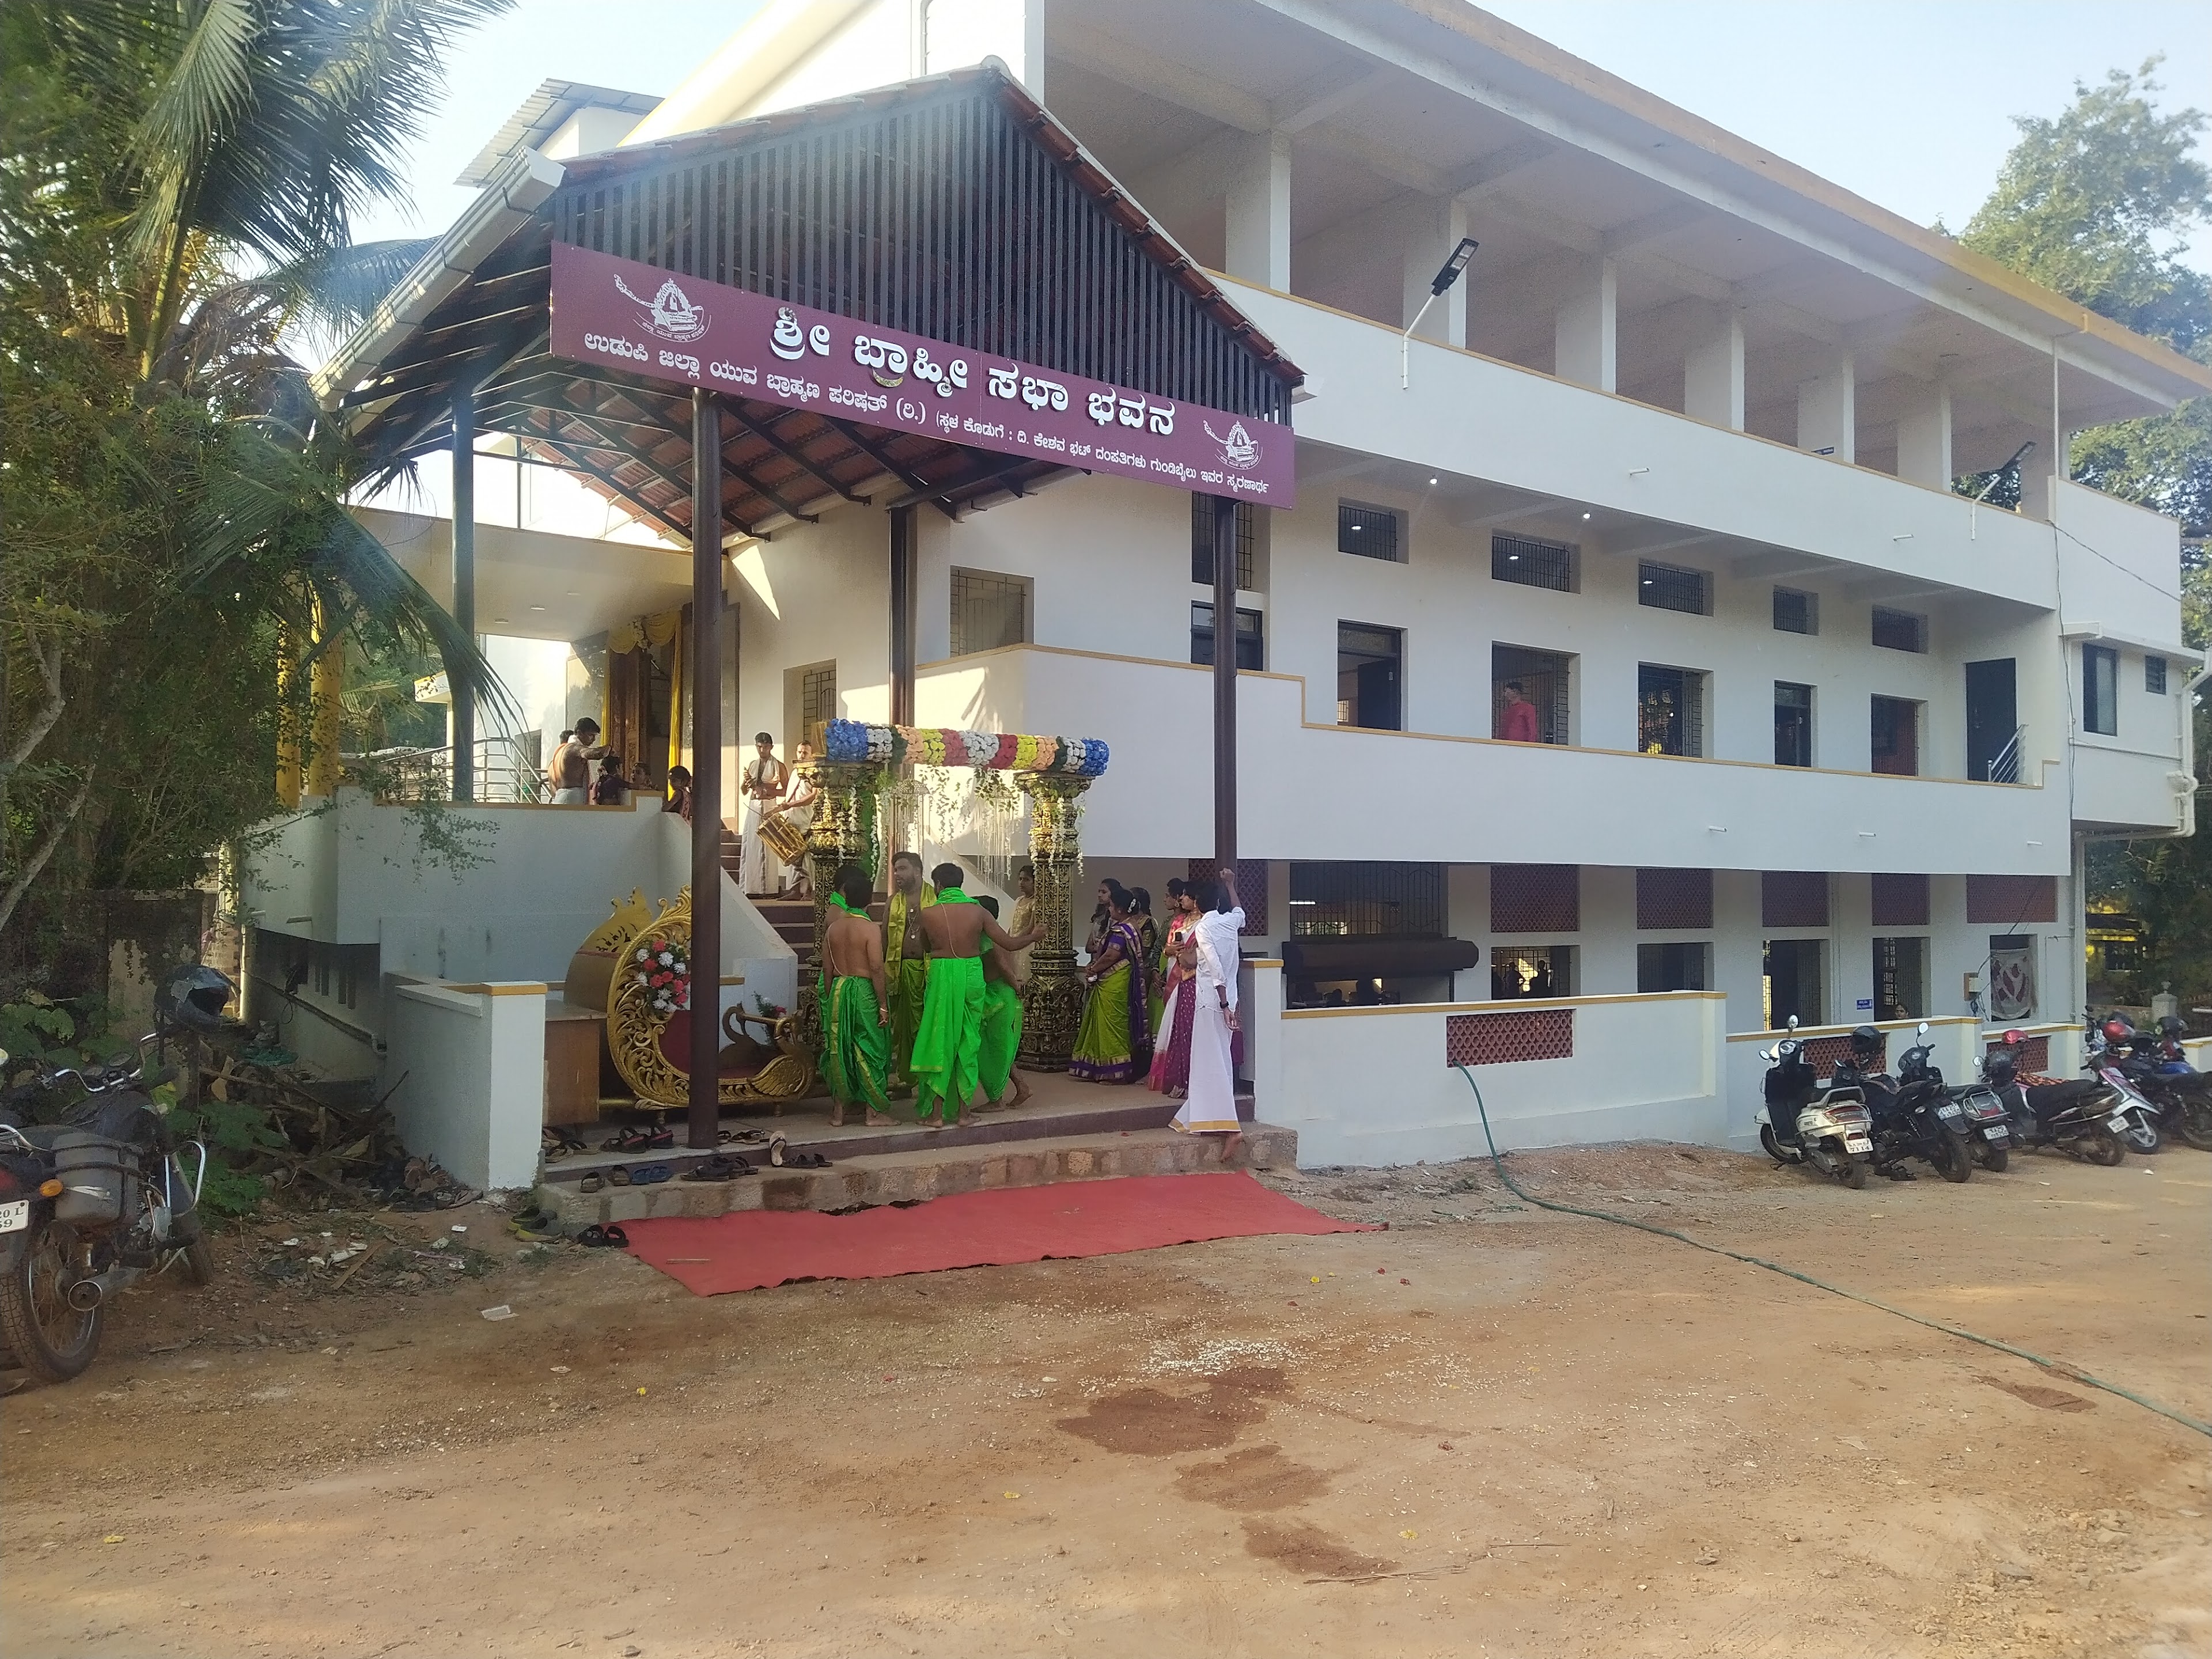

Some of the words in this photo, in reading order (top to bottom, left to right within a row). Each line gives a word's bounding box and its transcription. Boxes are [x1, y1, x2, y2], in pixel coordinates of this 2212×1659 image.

[585, 334, 648, 361] ಉಡುಪಿ
[660, 350, 699, 379] ಜಿಲ್ಲಾ
[710, 359, 757, 384] ಯುವ
[767, 374, 820, 402] ಬ್ರಾಹ್ಮಣ
[829, 384, 887, 411] ಪರಿಷತ್
[897, 398, 925, 424] (ರಿ.)
[770, 308, 830, 359] ಶ್ರೀ
[854, 335, 968, 397] ಬ್ರಾಹ್ಮೀ
[989, 363, 1068, 410] ಸಭಾ
[1089, 387, 1175, 434] ಭವನ
[964, 418, 1003, 438] ಕೊಡುಗೆ
[1034, 433, 1065, 451] ಕೇಶವ
[1070, 441, 1090, 456] ಭಟ್
[1096, 447, 1146, 468] ದಂಪತಿಗಳು
[1201, 470, 1223, 483] ಇವರ
[0, 1209, 10, 1218] 0
[15, 1207, 24, 1215] L
